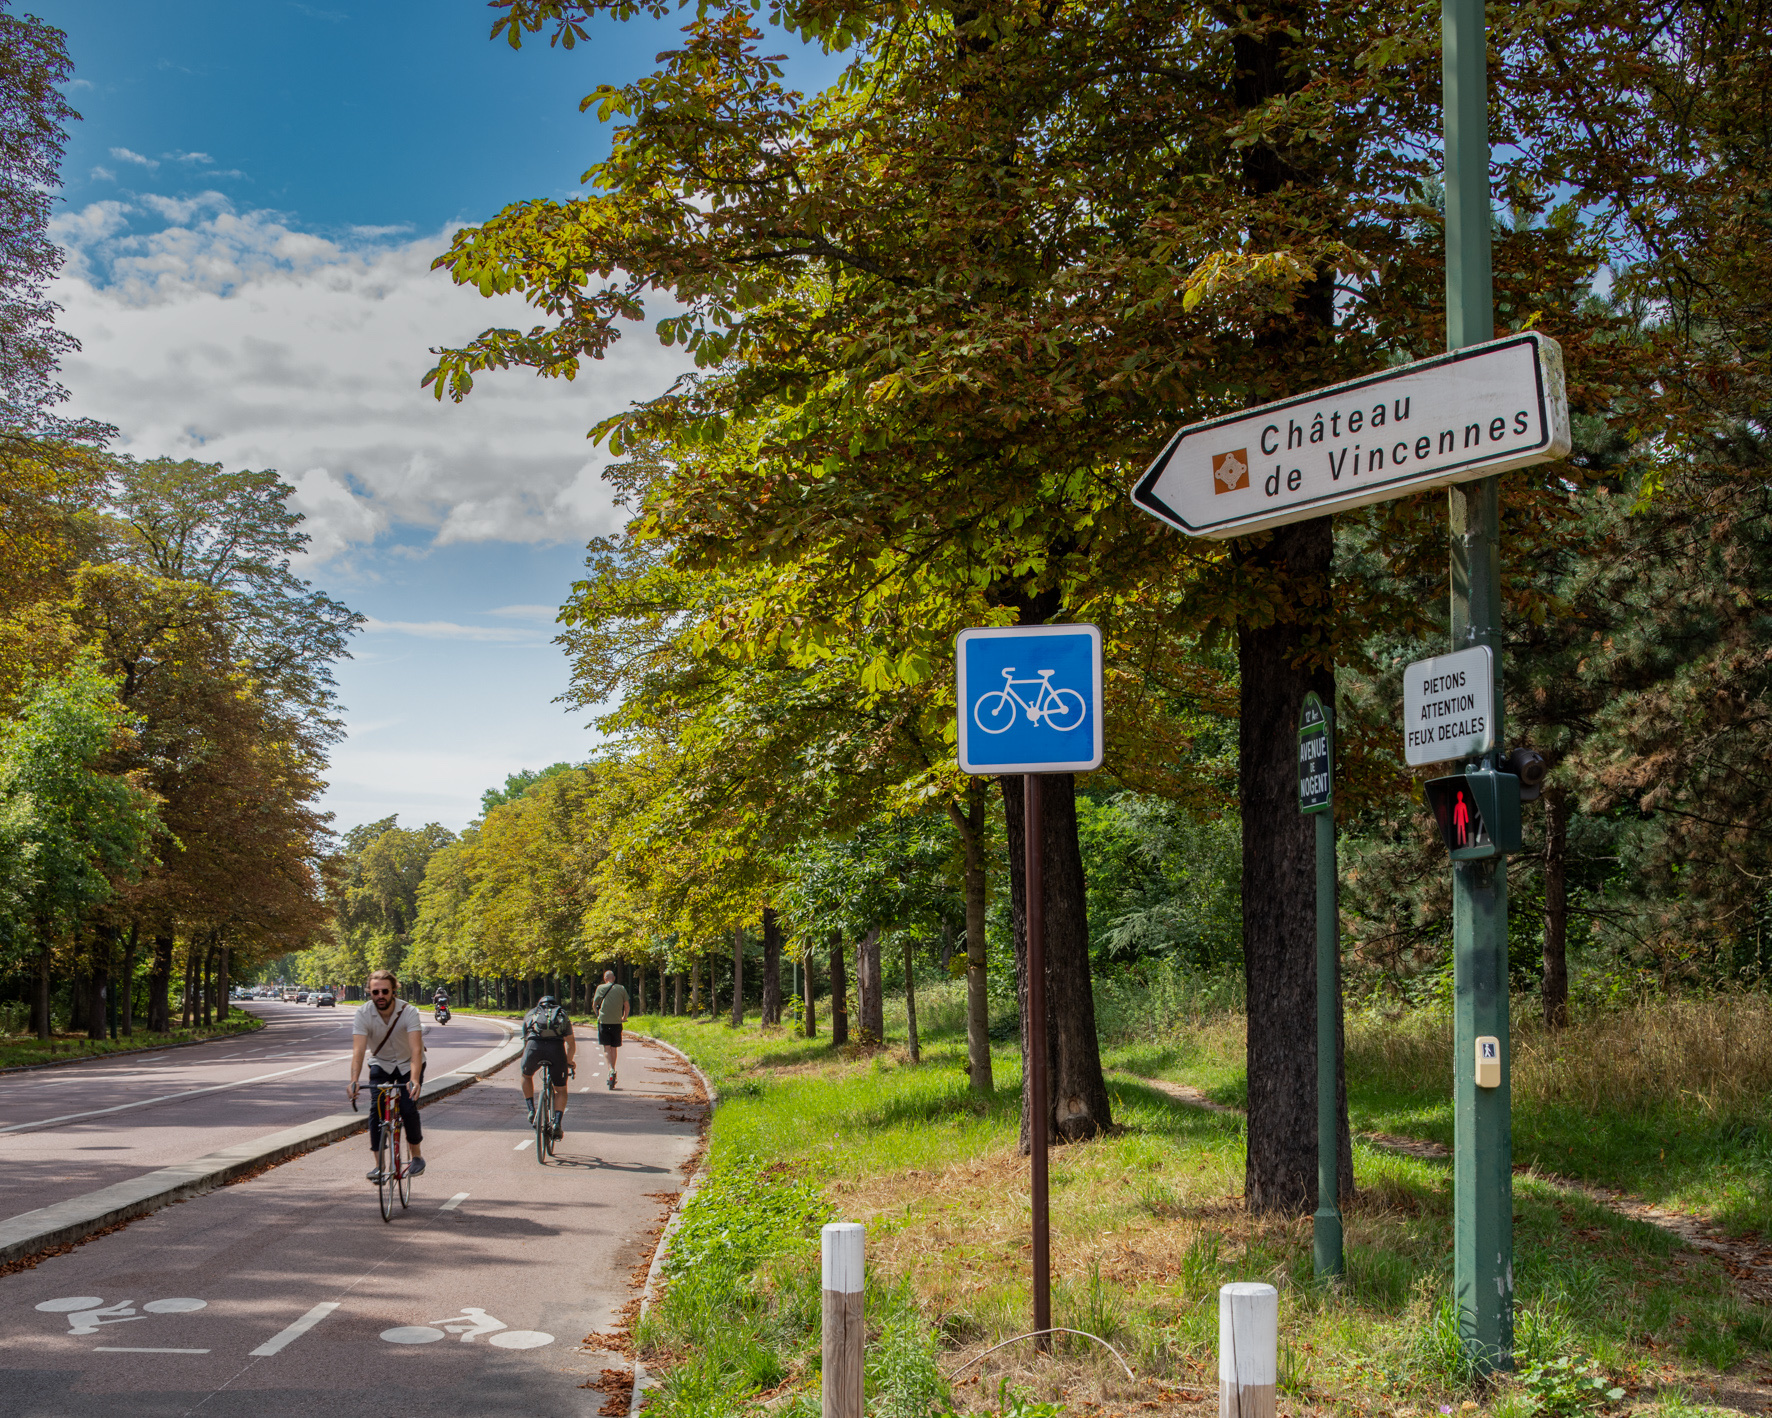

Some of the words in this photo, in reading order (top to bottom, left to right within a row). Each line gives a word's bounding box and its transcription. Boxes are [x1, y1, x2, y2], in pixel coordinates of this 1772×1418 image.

[1260, 396, 1411, 457] Château
[1264, 464, 1303, 498] de
[1328, 410, 1530, 482] Vincennes
[1423, 671, 1466, 696] PIETONS
[1420, 693, 1475, 721] ATTENTION
[1408, 727, 1435, 748] FEUX
[1438, 716, 1485, 742] DECALES
[1300, 736, 1328, 763] AVENUE
[1300, 772, 1328, 798] NOGENT
